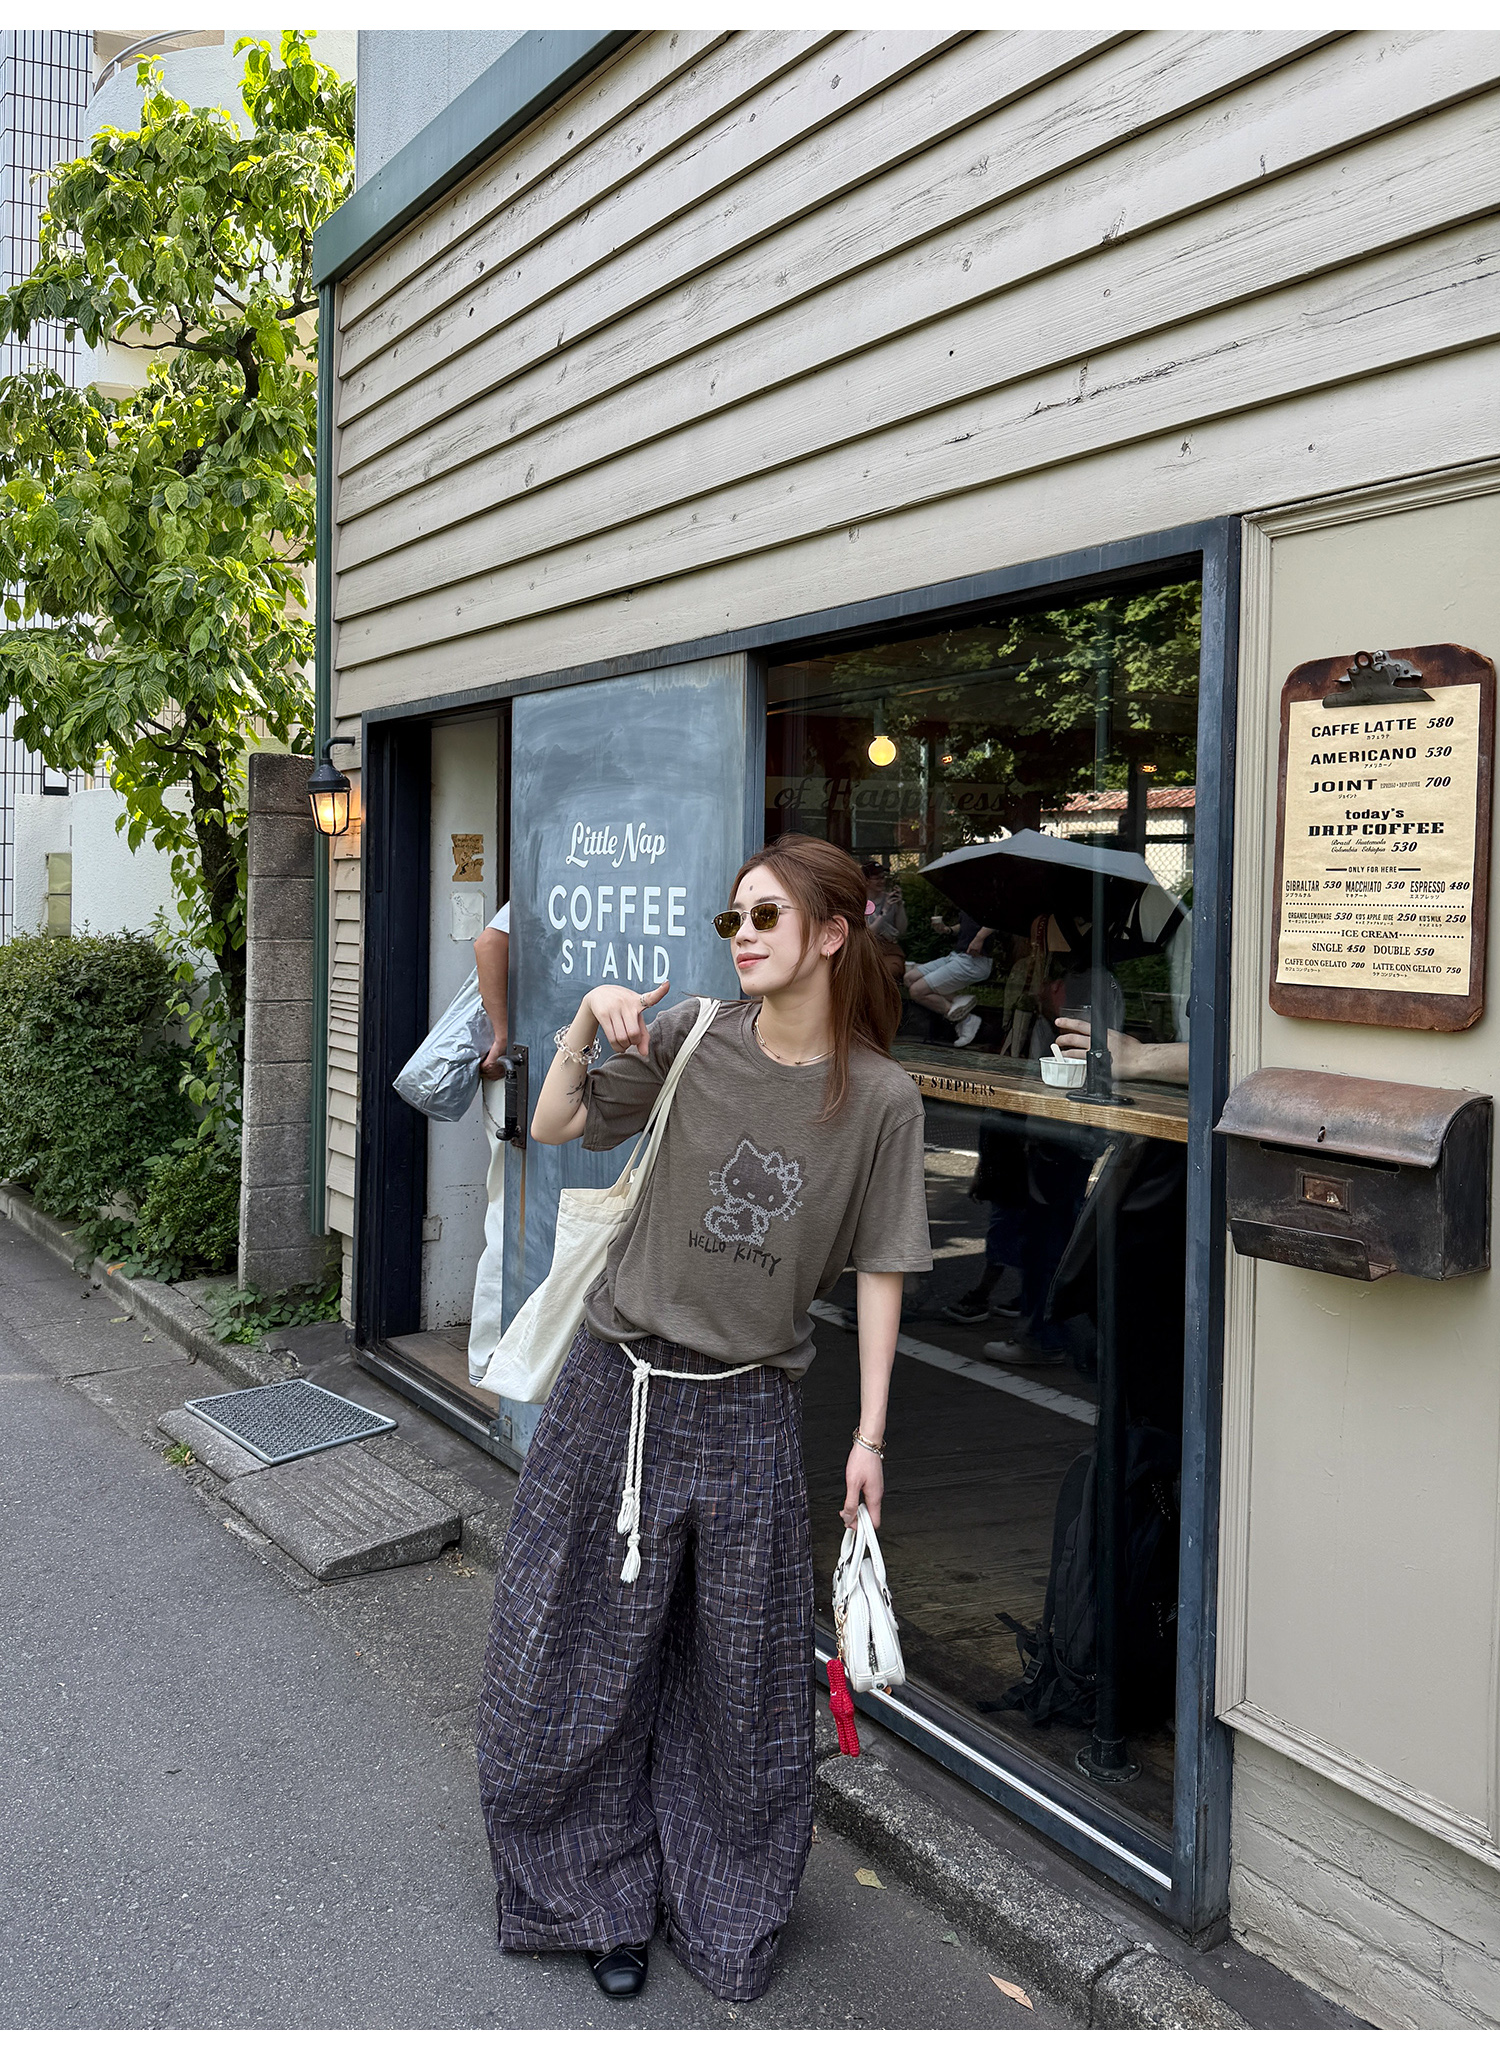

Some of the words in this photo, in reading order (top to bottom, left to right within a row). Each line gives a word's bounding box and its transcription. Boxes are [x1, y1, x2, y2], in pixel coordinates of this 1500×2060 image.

[1311, 723, 1360, 738] CAFFE
[1364, 718, 1417, 734] LATTE
[1426, 716, 1455, 729] 580
[1310, 747, 1417, 765] AMERICANO
[1424, 746, 1453, 758] 530
[1309, 779, 1378, 794] JOINT
[1424, 776, 1452, 788] 700
[773, 778, 809, 811] of
[1345, 808, 1405, 821] today's
[1308, 824, 1359, 837] DRIP
[1361, 822, 1444, 835] COFFEE
[565, 821, 619, 869] Little
[611, 822, 666, 869] Nap
[1390, 841, 1418, 852] 530
[1285, 880, 1320, 892] GIBRALTAR
[1322, 880, 1342, 889] 530
[1345, 881, 1382, 893] MACCHIATO
[1385, 881, 1406, 890] 530
[1410, 881, 1446, 893] ESPRESSO
[1449, 881, 1471, 890] 480
[548, 884, 687, 937] COFFEE
[1333, 912, 1353, 921] 530
[1396, 913, 1417, 922] 250
[1445, 914, 1467, 923] 250
[1341, 929, 1359, 938] ICE
[1361, 930, 1399, 939] CREAM
[1311, 942, 1343, 953] SINGLE
[1346, 944, 1366, 954] 450
[1373, 945, 1411, 956] DOUBLE
[1413, 947, 1435, 957] 550
[561, 939, 670, 985] STAND
[1284, 958, 1304, 966] CAFFE
[1304, 959, 1319, 967] CON
[1320, 960, 1347, 968] GELATO
[1372, 962, 1394, 971] LATTE
[1395, 964, 1411, 972] CON
[1412, 965, 1442, 973] GELATO
[1446, 966, 1462, 974] 750
[931, 1076, 996, 1097] STEPPERS
[688, 1230, 727, 1254] HELLO
[733, 1243, 782, 1277] KITTY
